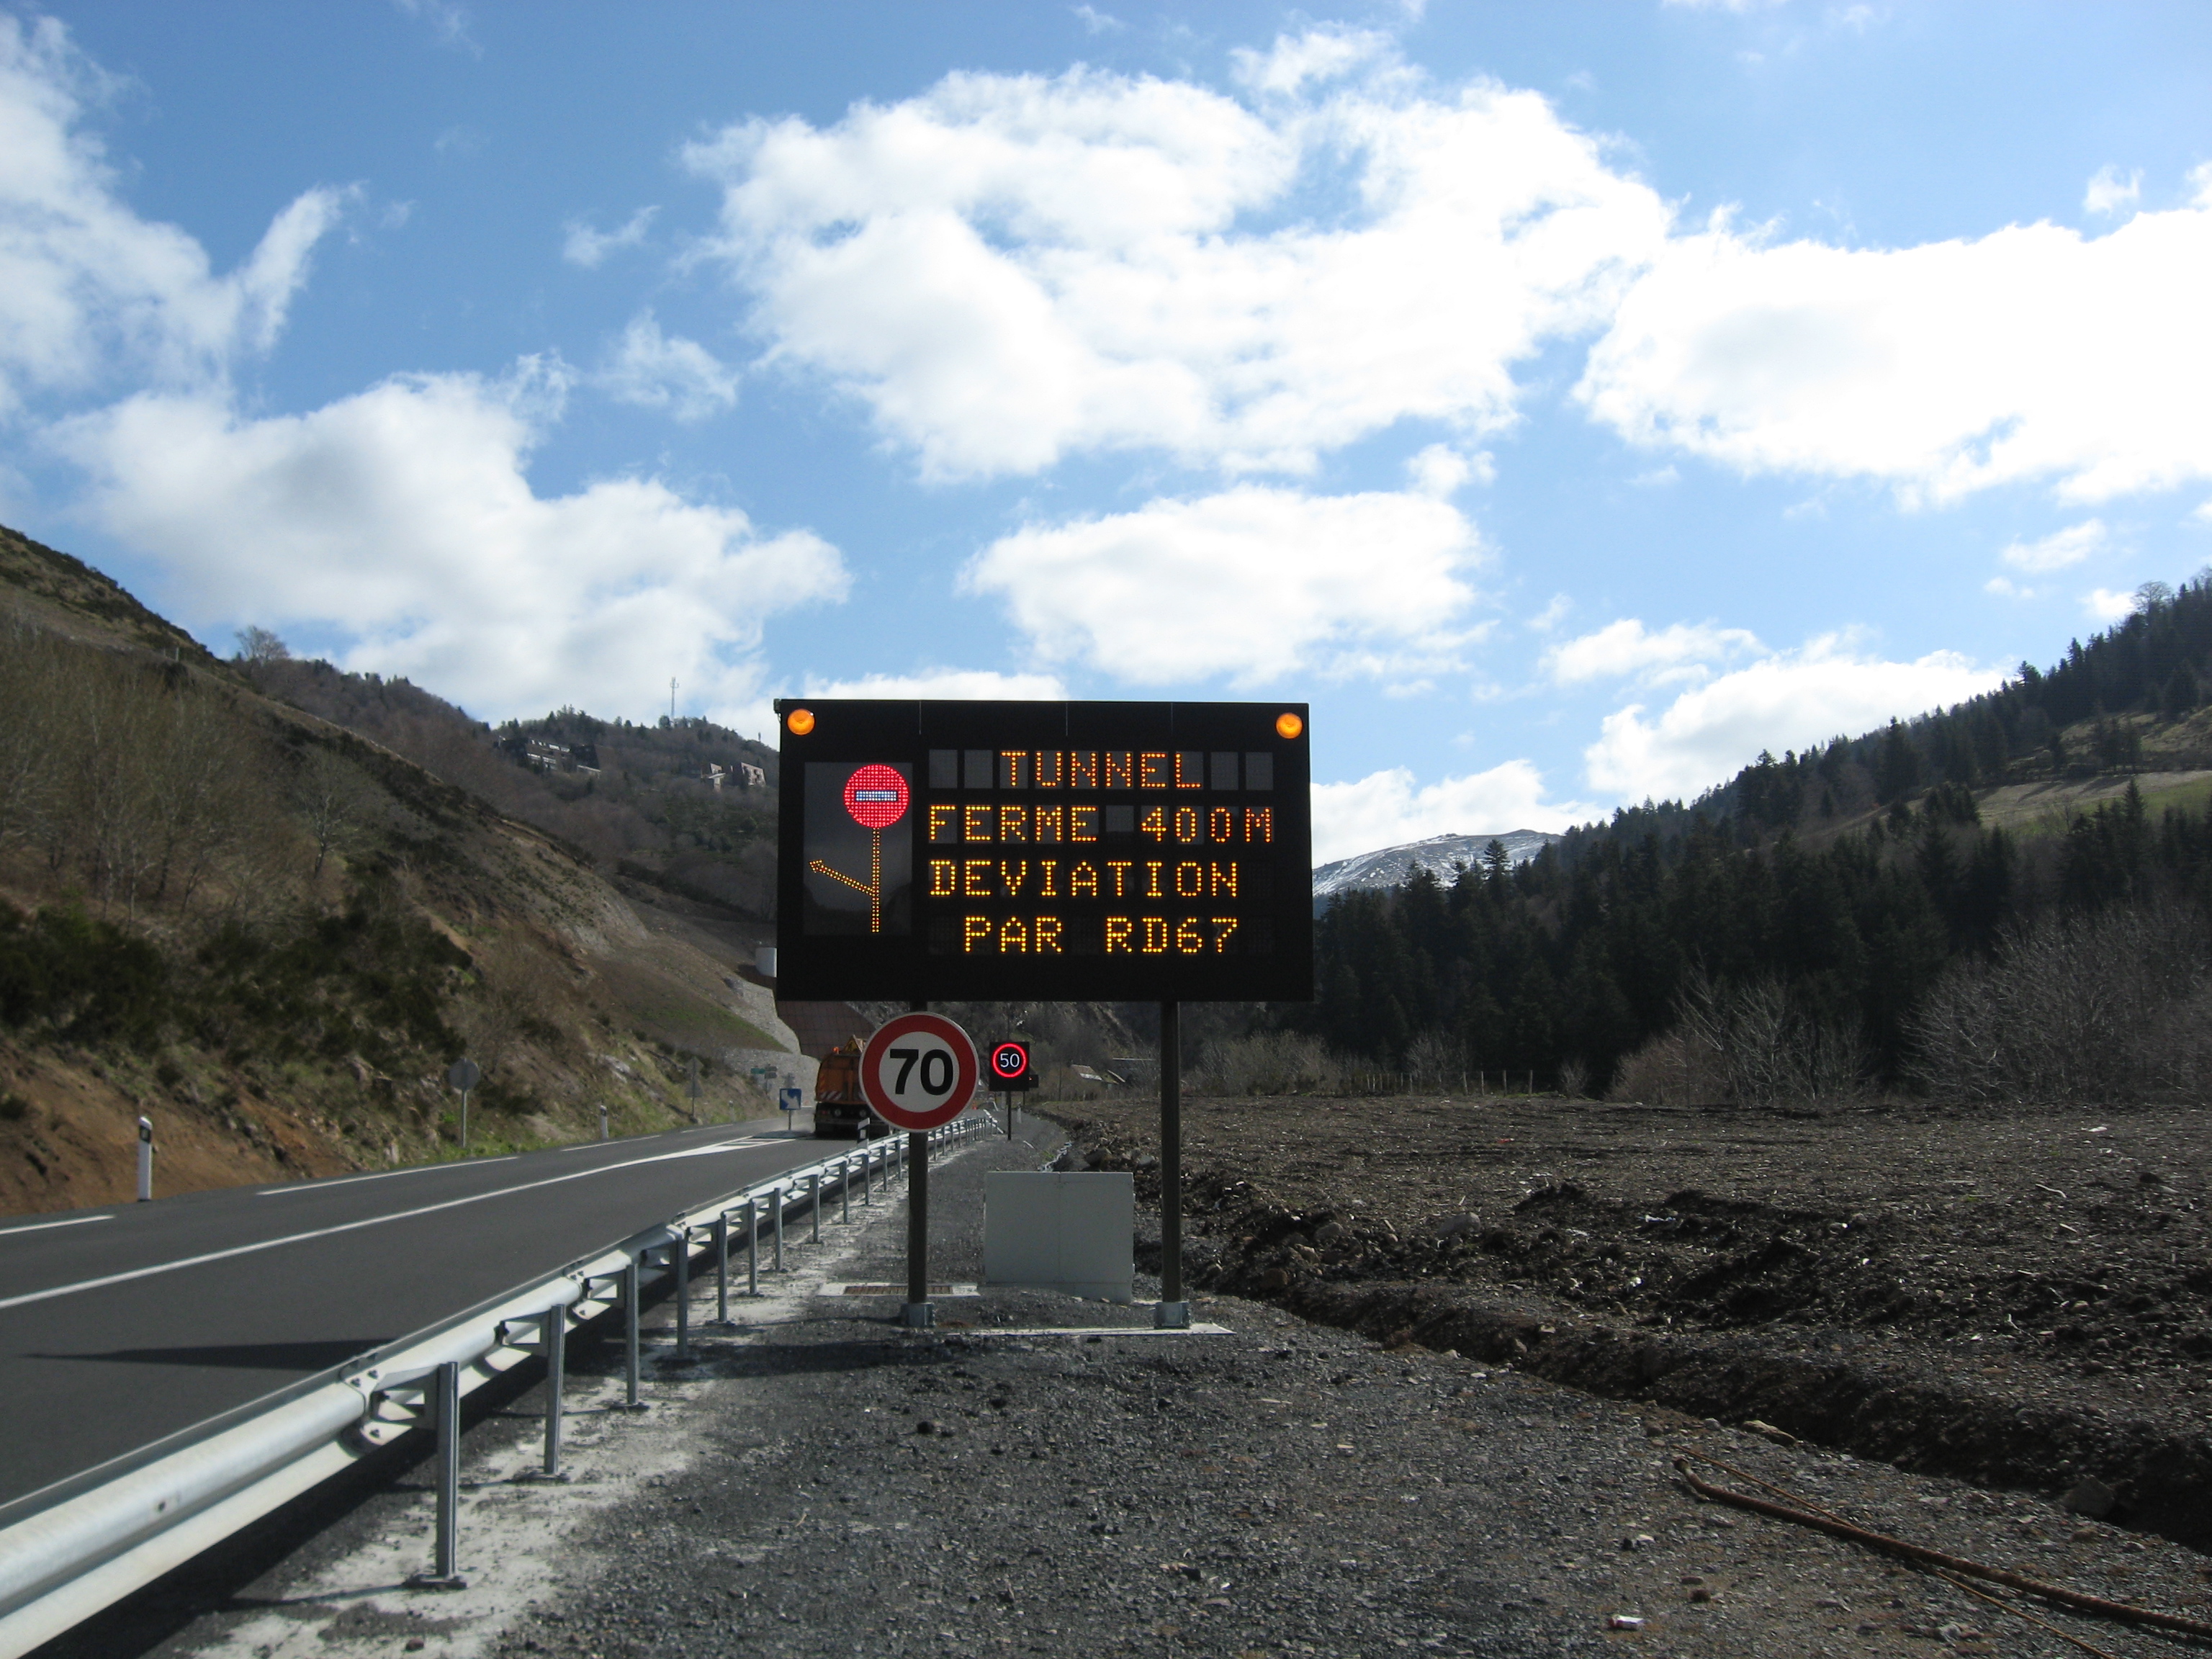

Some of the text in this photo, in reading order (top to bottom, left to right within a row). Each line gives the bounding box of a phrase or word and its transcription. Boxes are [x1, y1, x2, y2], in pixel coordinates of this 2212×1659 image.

[1000, 750, 1202, 789] TUNNEL
[930, 804, 1097, 842] FERME
[930, 859, 1238, 898] DEVIATION
[964, 916, 1238, 954] PAR RD67
[889, 1048, 954, 1096] 70
[999, 1053, 1020, 1068] 50
